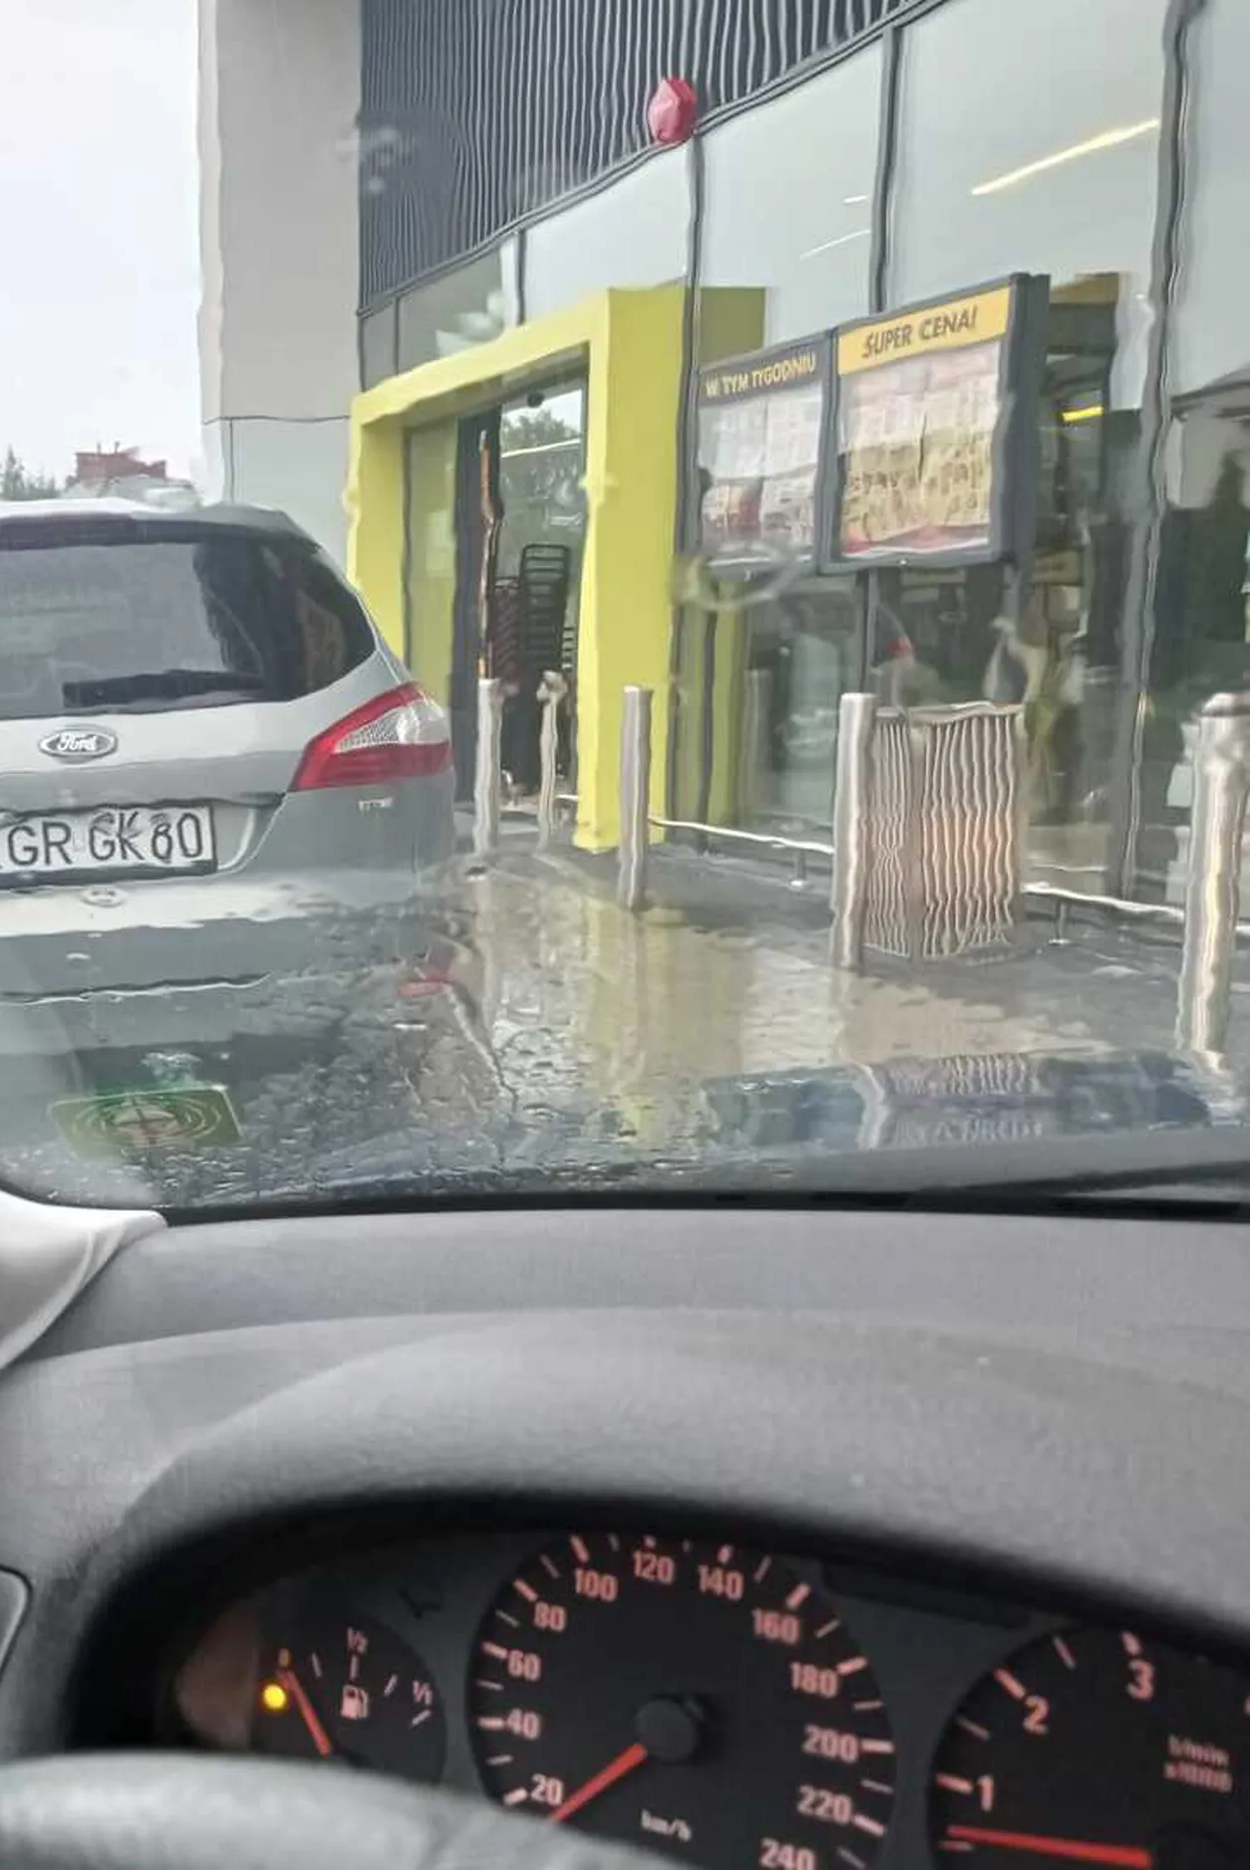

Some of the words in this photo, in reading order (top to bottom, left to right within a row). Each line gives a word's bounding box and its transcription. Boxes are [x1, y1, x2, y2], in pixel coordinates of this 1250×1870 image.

[861, 323, 912, 359] SUPER
[918, 304, 979, 341] CENA!
[706, 376, 721, 399] W
[723, 372, 749, 395] TYM
[751, 350, 817, 389] TYGODNIU
[57, 732, 98, 752] Ford
[575, 1568, 618, 1603] 100
[633, 1550, 676, 1585] 120
[698, 1564, 745, 1602] 140
[534, 1602, 567, 1632] 80
[752, 1608, 800, 1645] 160
[507, 1650, 542, 1682] 60
[790, 1661, 839, 1698] 180
[1125, 1658, 1154, 1701] 3
[506, 1708, 541, 1741] 40
[1022, 1694, 1050, 1735] 2
[803, 1724, 859, 1763] 200
[530, 1773, 564, 1806] 20
[797, 1785, 852, 1826] 220
[977, 1774, 994, 1812] 1
[759, 1837, 816, 1870] 240
